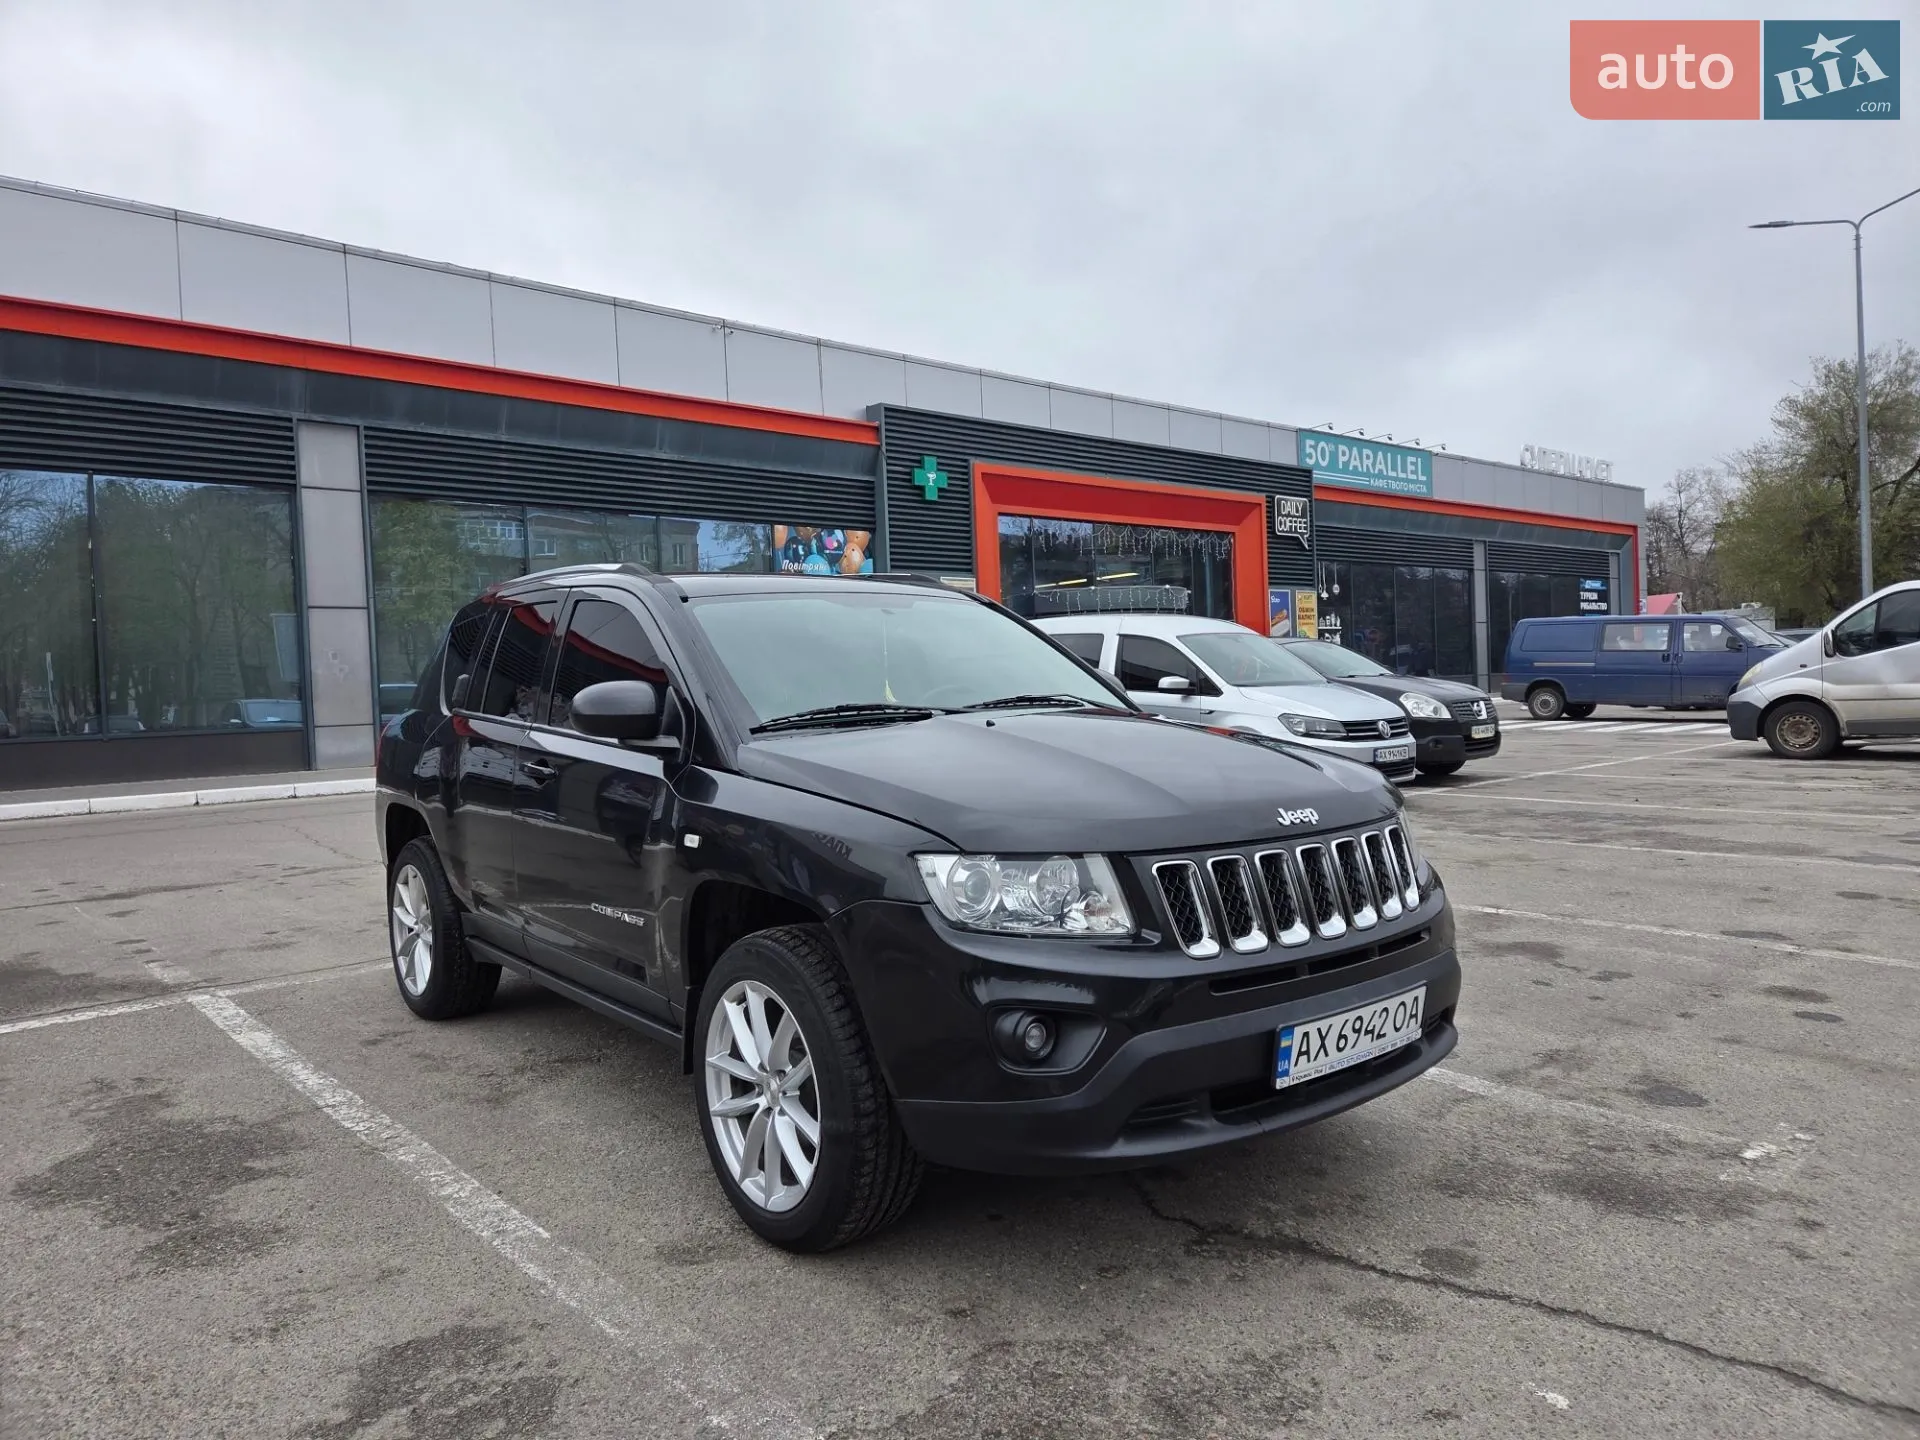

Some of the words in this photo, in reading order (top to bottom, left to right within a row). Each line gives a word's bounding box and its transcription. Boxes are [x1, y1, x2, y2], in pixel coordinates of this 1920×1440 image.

[1338, 444, 1427, 481] PARALLEL
[1370, 478, 1388, 489] КАФЕ
[1388, 480, 1409, 492] ТВОГО
[1409, 483, 1427, 493] МІСТА
[1281, 500, 1303, 516] DAILY
[1278, 516, 1307, 532] COFFEE
[1277, 808, 1319, 825] Jeep
[591, 903, 644, 926] COMPASS
[1294, 1023, 1333, 1068] AX
[1336, 1007, 1389, 1053] 6942
[1393, 996, 1419, 1033] OA
[1278, 1060, 1289, 1072] UA
